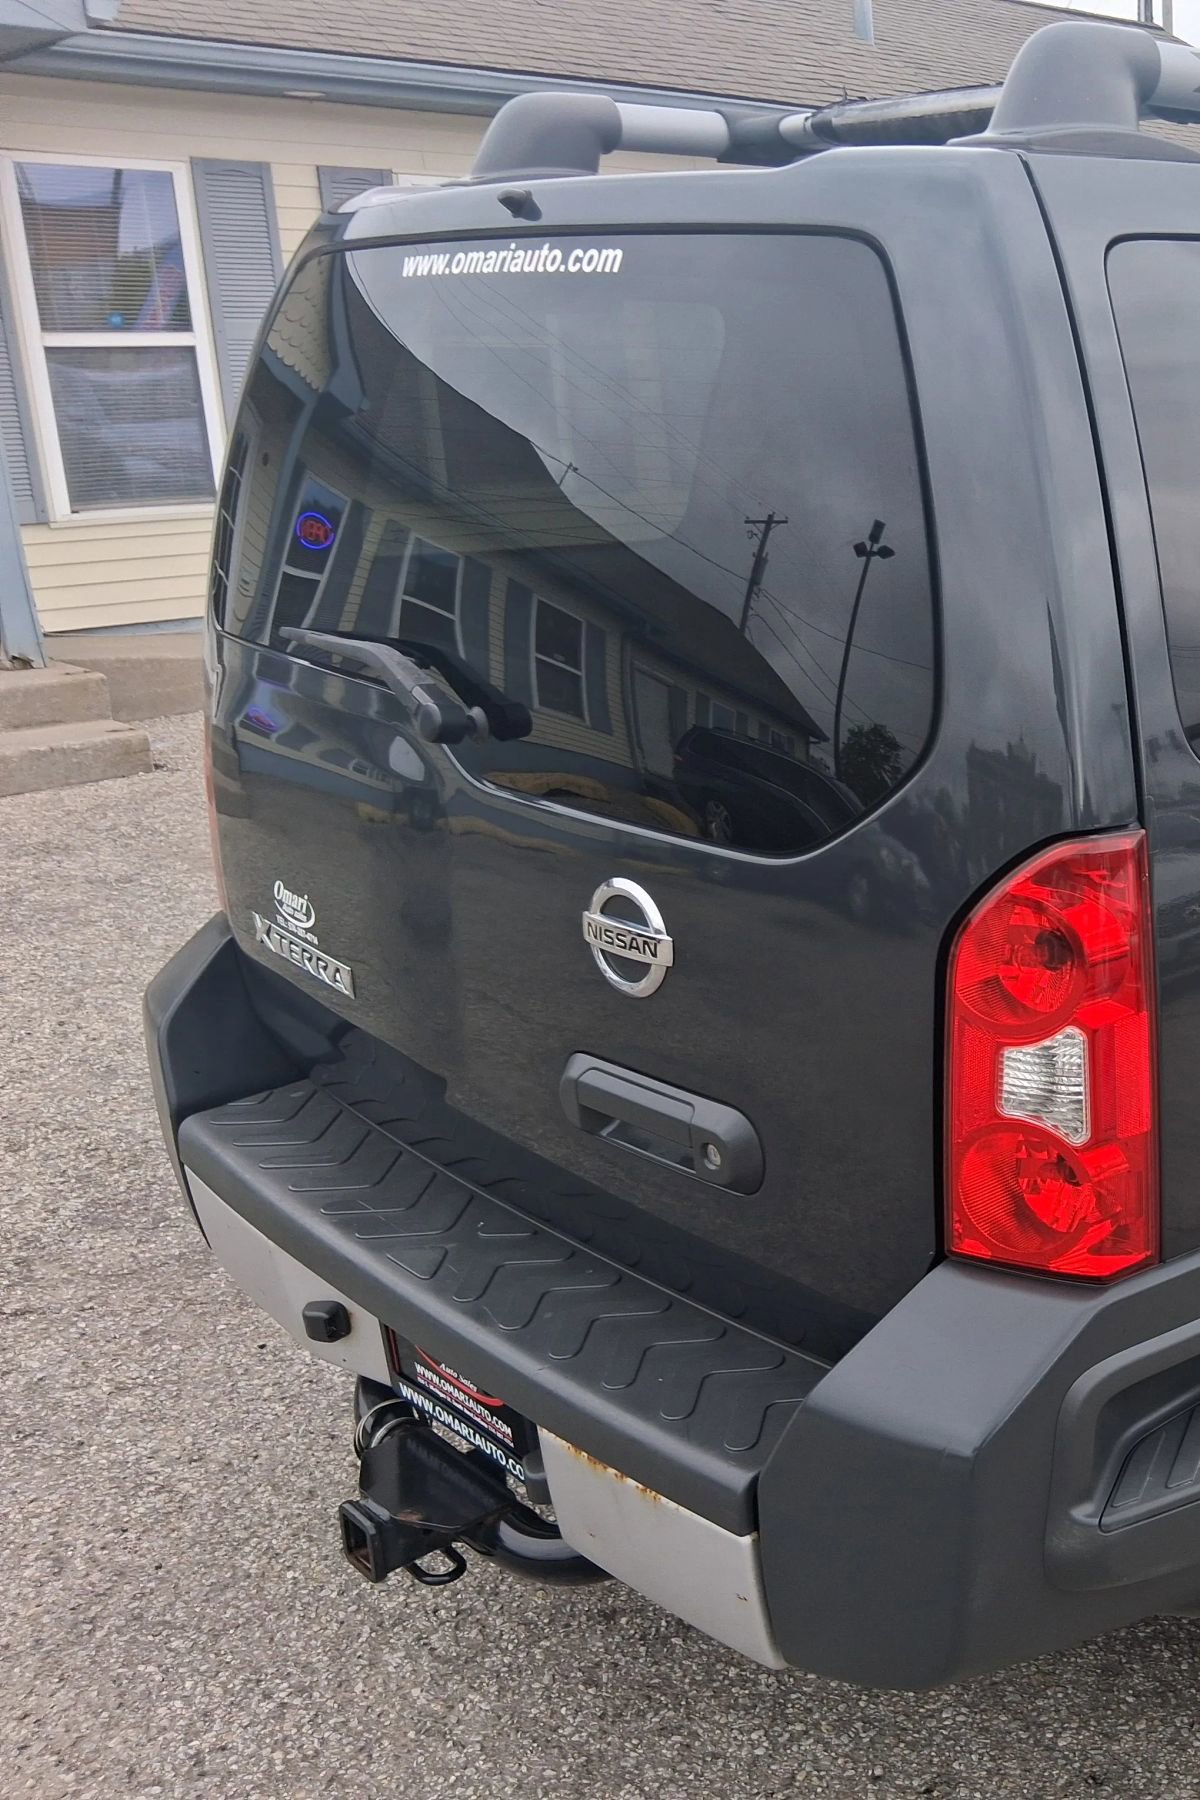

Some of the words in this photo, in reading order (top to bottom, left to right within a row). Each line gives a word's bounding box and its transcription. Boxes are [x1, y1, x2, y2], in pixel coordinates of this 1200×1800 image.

[402, 242, 623, 277] www.omariauto.com
[273, 880, 309, 914] Omari
[252, 911, 355, 999] XTERRA
[586, 921, 658, 958] NISSAN
[414, 1361, 513, 1437] WWW.OMARIAUTO.COM
[399, 1382, 525, 1481] WWW.OMARIAUTO.CO
